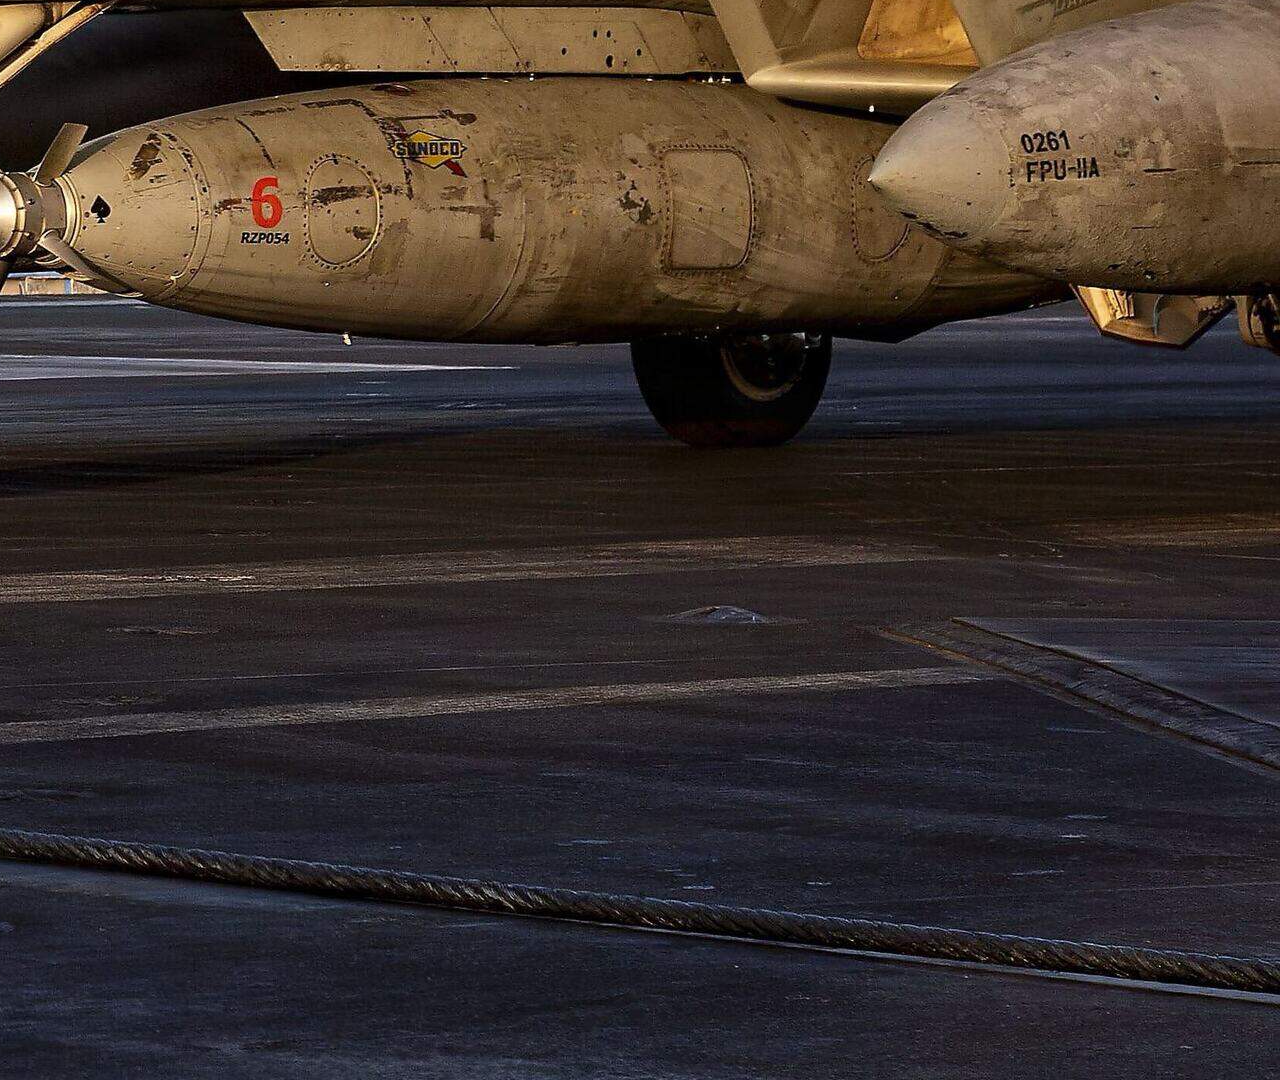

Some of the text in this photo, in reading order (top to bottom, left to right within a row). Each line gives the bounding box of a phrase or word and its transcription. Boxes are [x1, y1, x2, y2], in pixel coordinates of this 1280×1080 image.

[395, 141, 461, 157] SUNOCO
[1020, 129, 1071, 154] 0261
[251, 176, 283, 229] 6
[240, 231, 290, 245] RZP054
